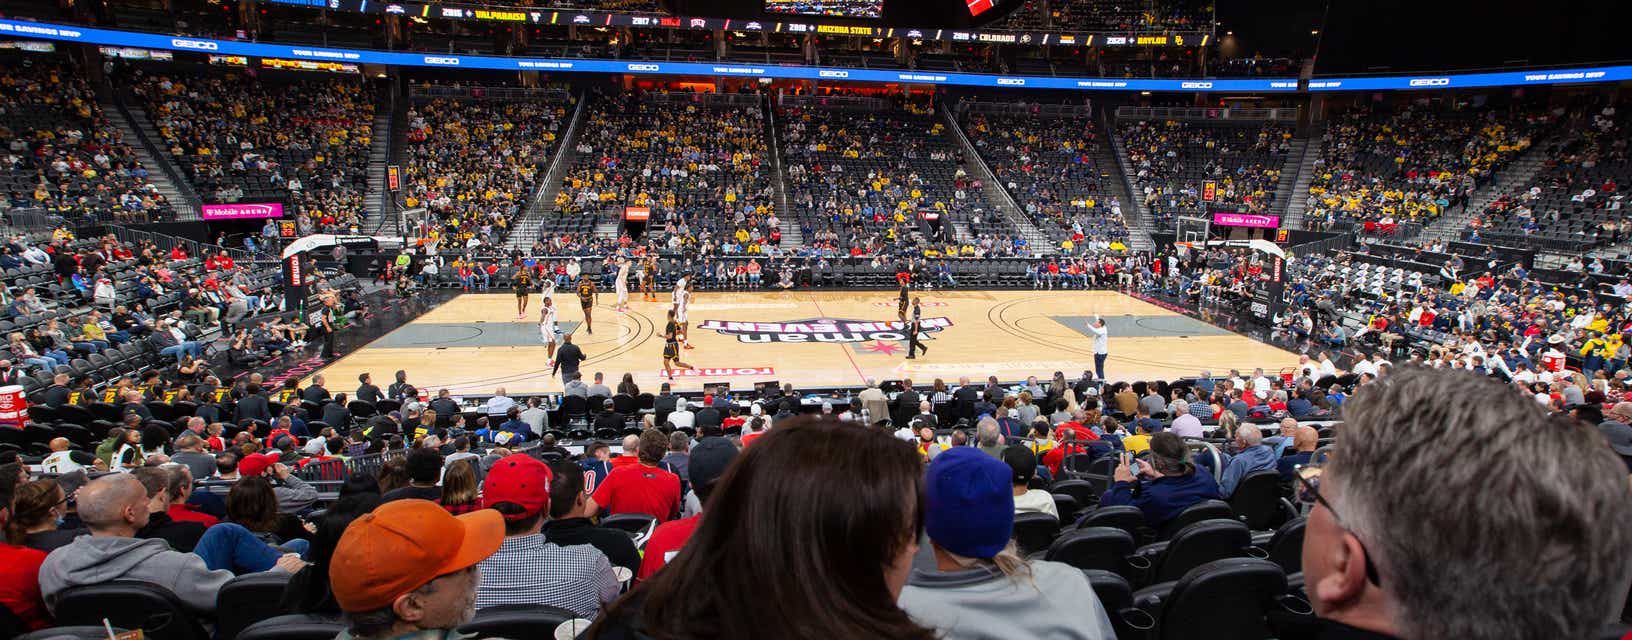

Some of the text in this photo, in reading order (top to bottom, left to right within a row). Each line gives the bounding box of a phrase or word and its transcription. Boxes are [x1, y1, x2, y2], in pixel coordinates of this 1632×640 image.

[475, 10, 527, 21] VALPARAISO
[0, 23, 82, 38] UR SAVINGS MVP
[817, 25, 849, 34] ARIZONA
[850, 26, 872, 35] STATE
[979, 33, 1016, 42] COLORADO
[1137, 37, 1167, 45] BAYLOR
[172, 39, 218, 50] GEICO
[424, 56, 460, 65] GEICO
[628, 63, 659, 72] GEICO
[819, 70, 848, 78] GEICO
[1584, 71, 1606, 79] MVP
[997, 78, 1025, 86] GEICO
[1409, 78, 1450, 87] GEICO
[702, 317, 953, 333] MAIN EVENT
